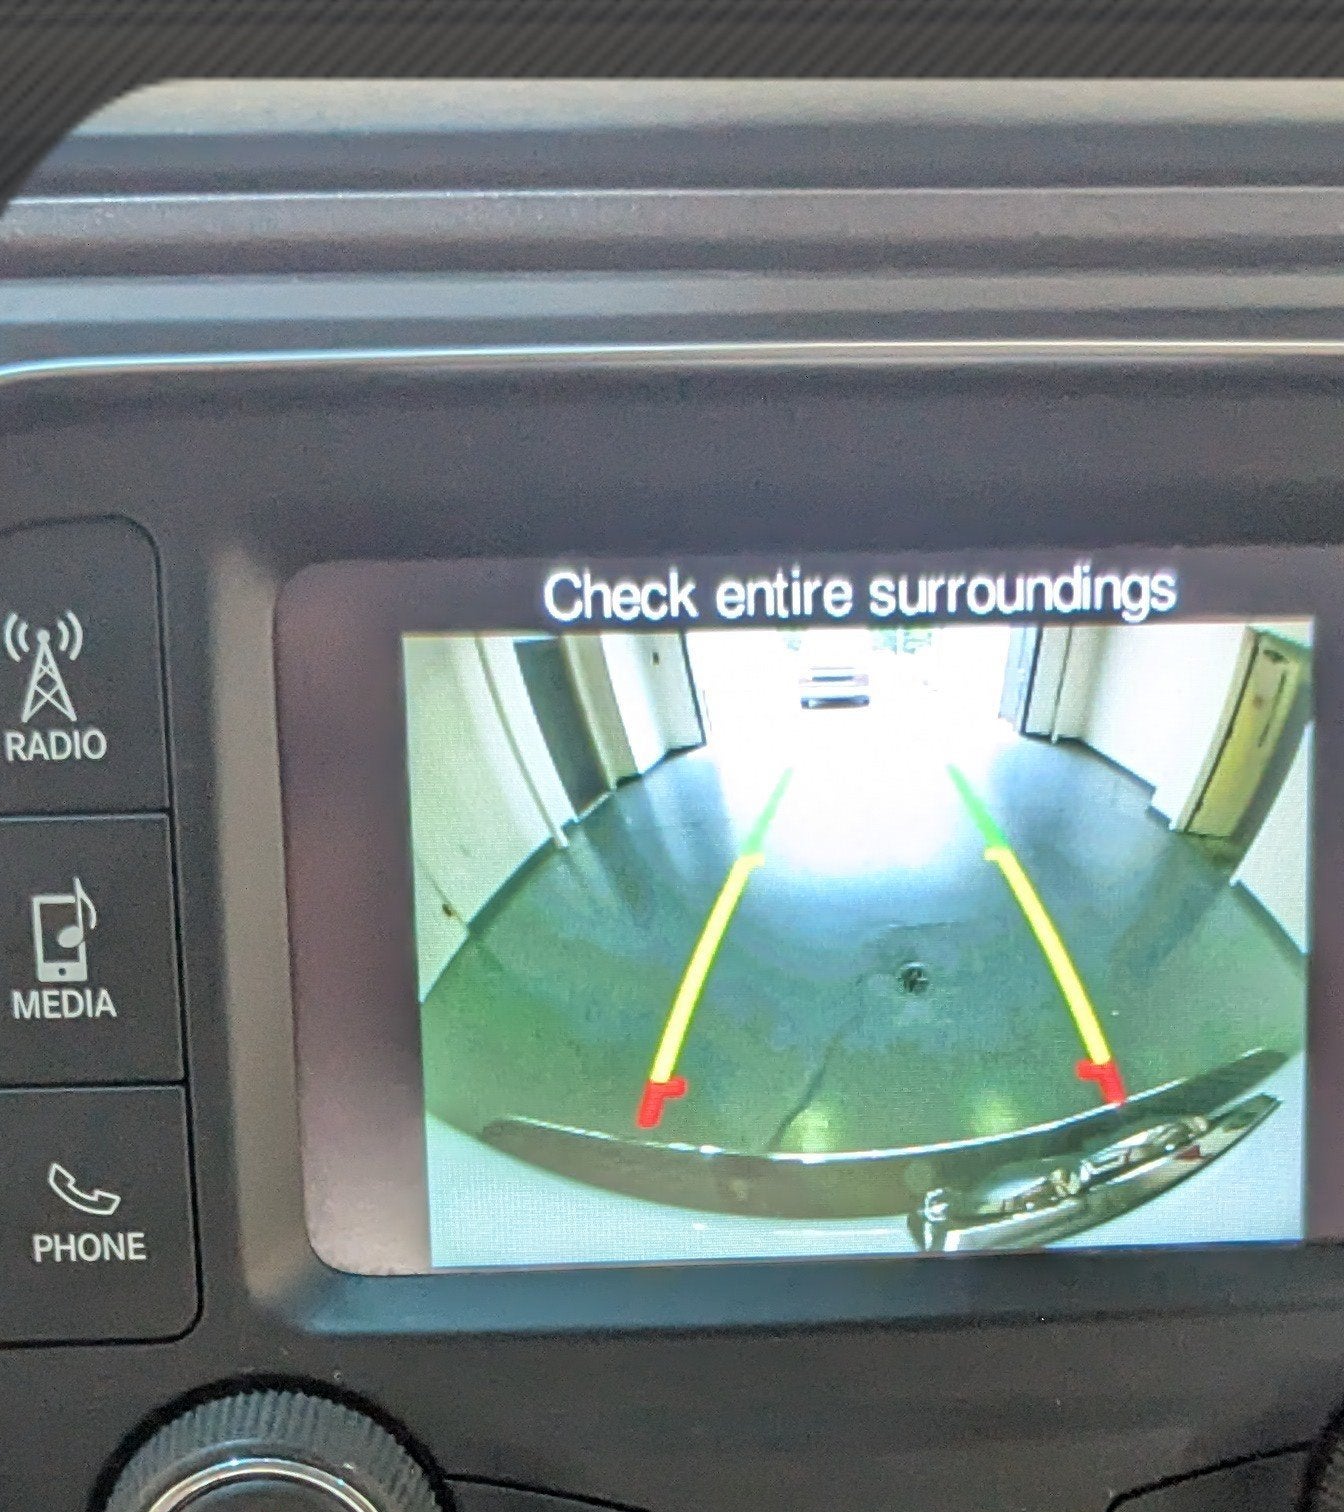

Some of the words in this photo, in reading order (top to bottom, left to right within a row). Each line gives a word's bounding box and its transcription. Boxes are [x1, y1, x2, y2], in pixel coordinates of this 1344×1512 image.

[542, 564, 701, 623] Check
[714, 565, 854, 621] entire
[867, 561, 1177, 623] surroundings
[4, 727, 109, 763] RADIO
[10, 987, 118, 1021] MEDIA
[32, 1231, 148, 1264] PHONE
